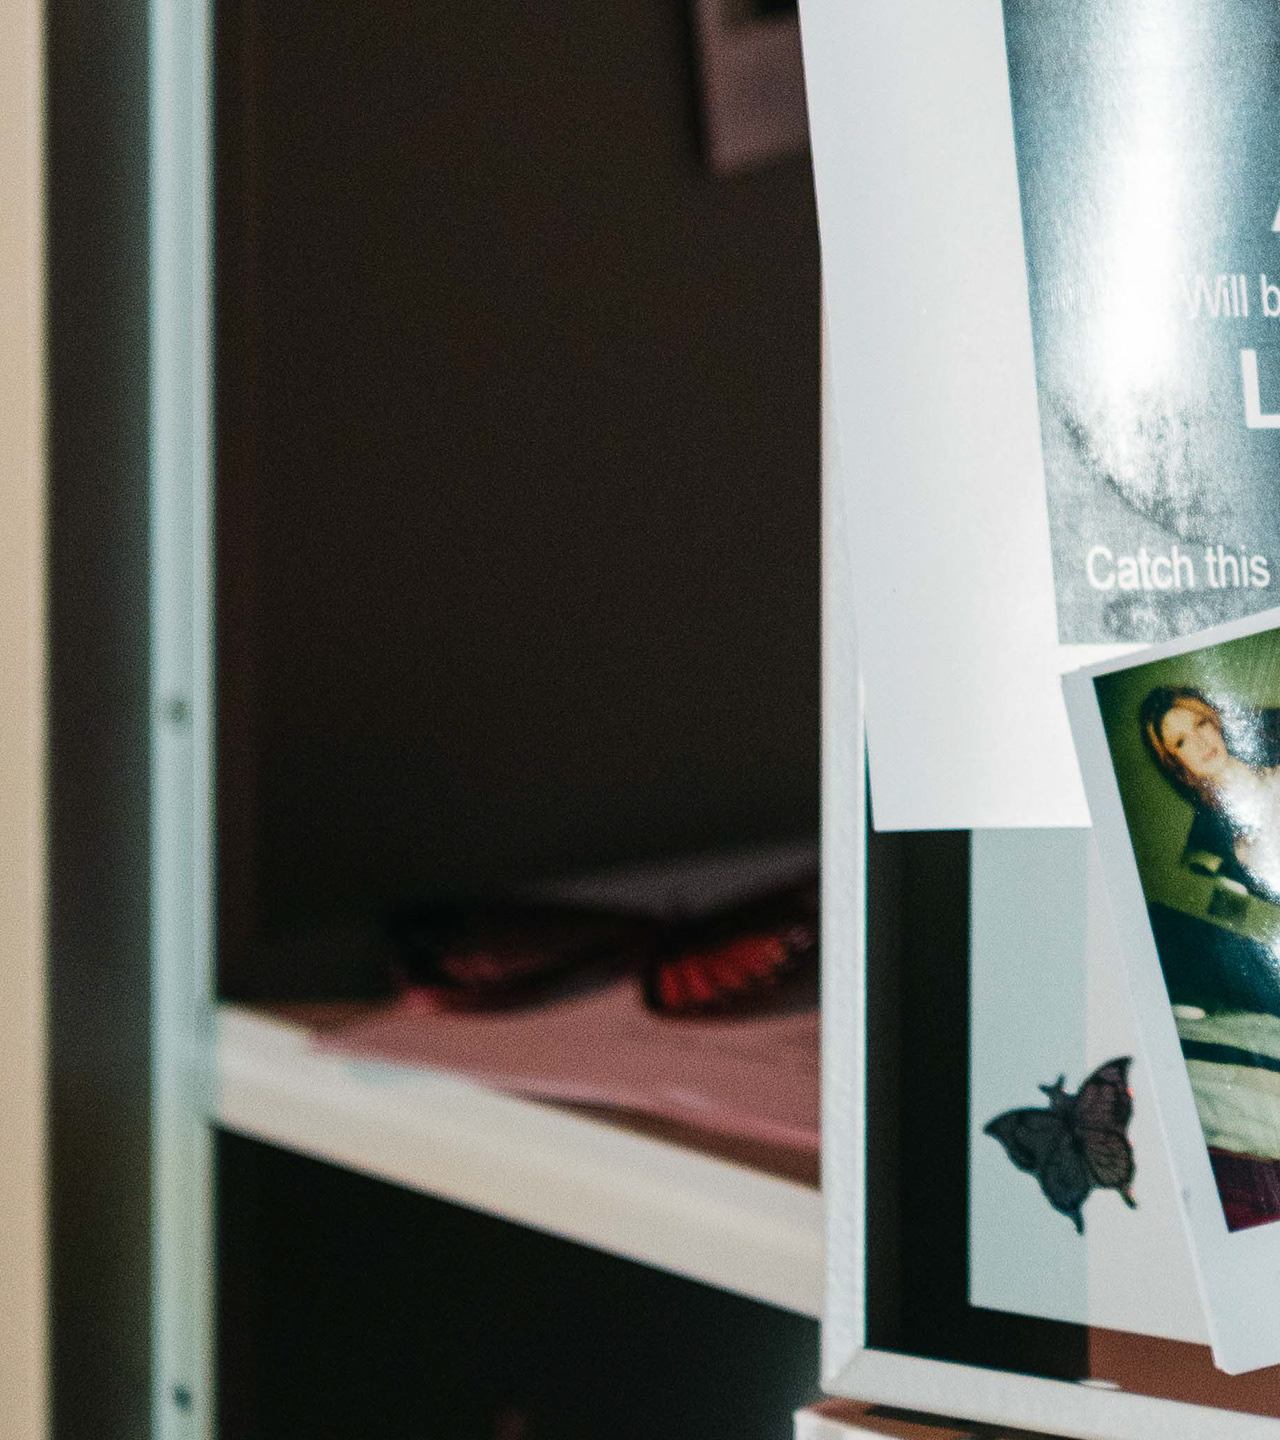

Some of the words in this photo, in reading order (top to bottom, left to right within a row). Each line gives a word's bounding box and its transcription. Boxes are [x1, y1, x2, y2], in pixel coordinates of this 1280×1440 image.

[1184, 275, 1248, 318] Will
[1086, 545, 1194, 590] Catch
[1204, 545, 1270, 588] this
